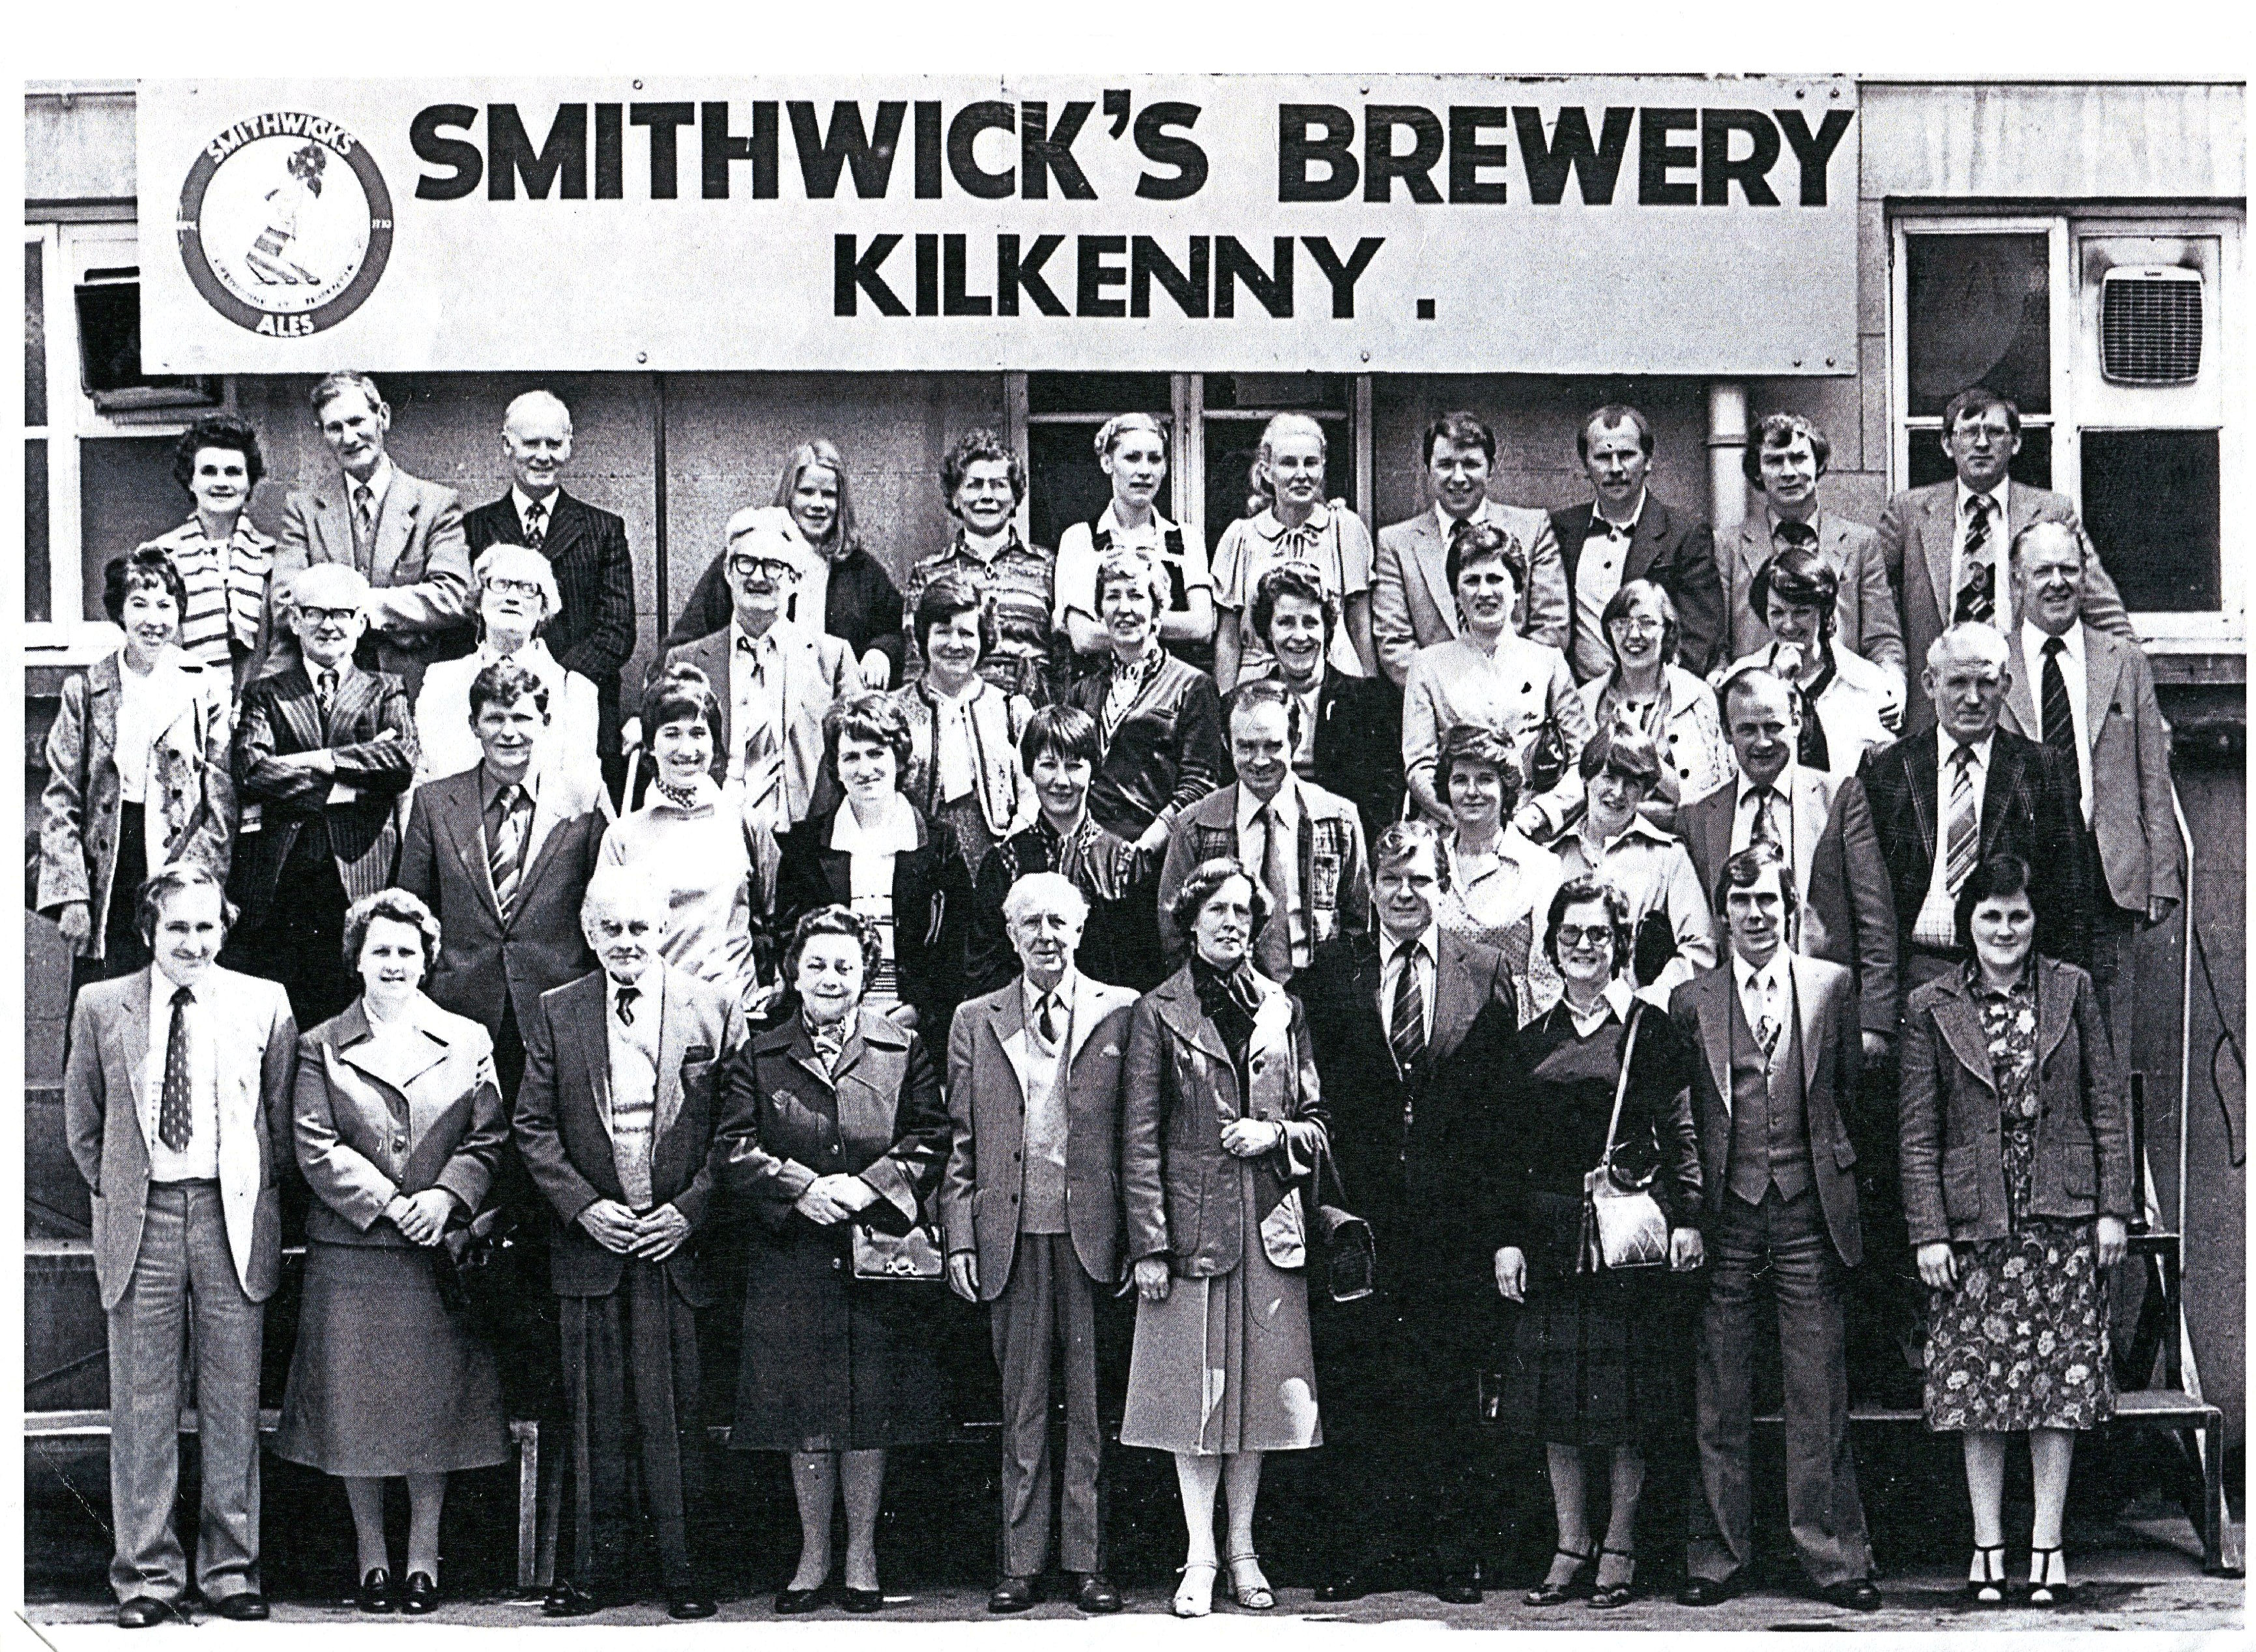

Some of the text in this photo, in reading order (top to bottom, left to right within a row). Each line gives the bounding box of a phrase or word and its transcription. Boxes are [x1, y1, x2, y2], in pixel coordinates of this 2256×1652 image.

[410, 89, 1855, 207] SMITHWICK'S BREWERY
[256, 313, 315, 336] ALES
